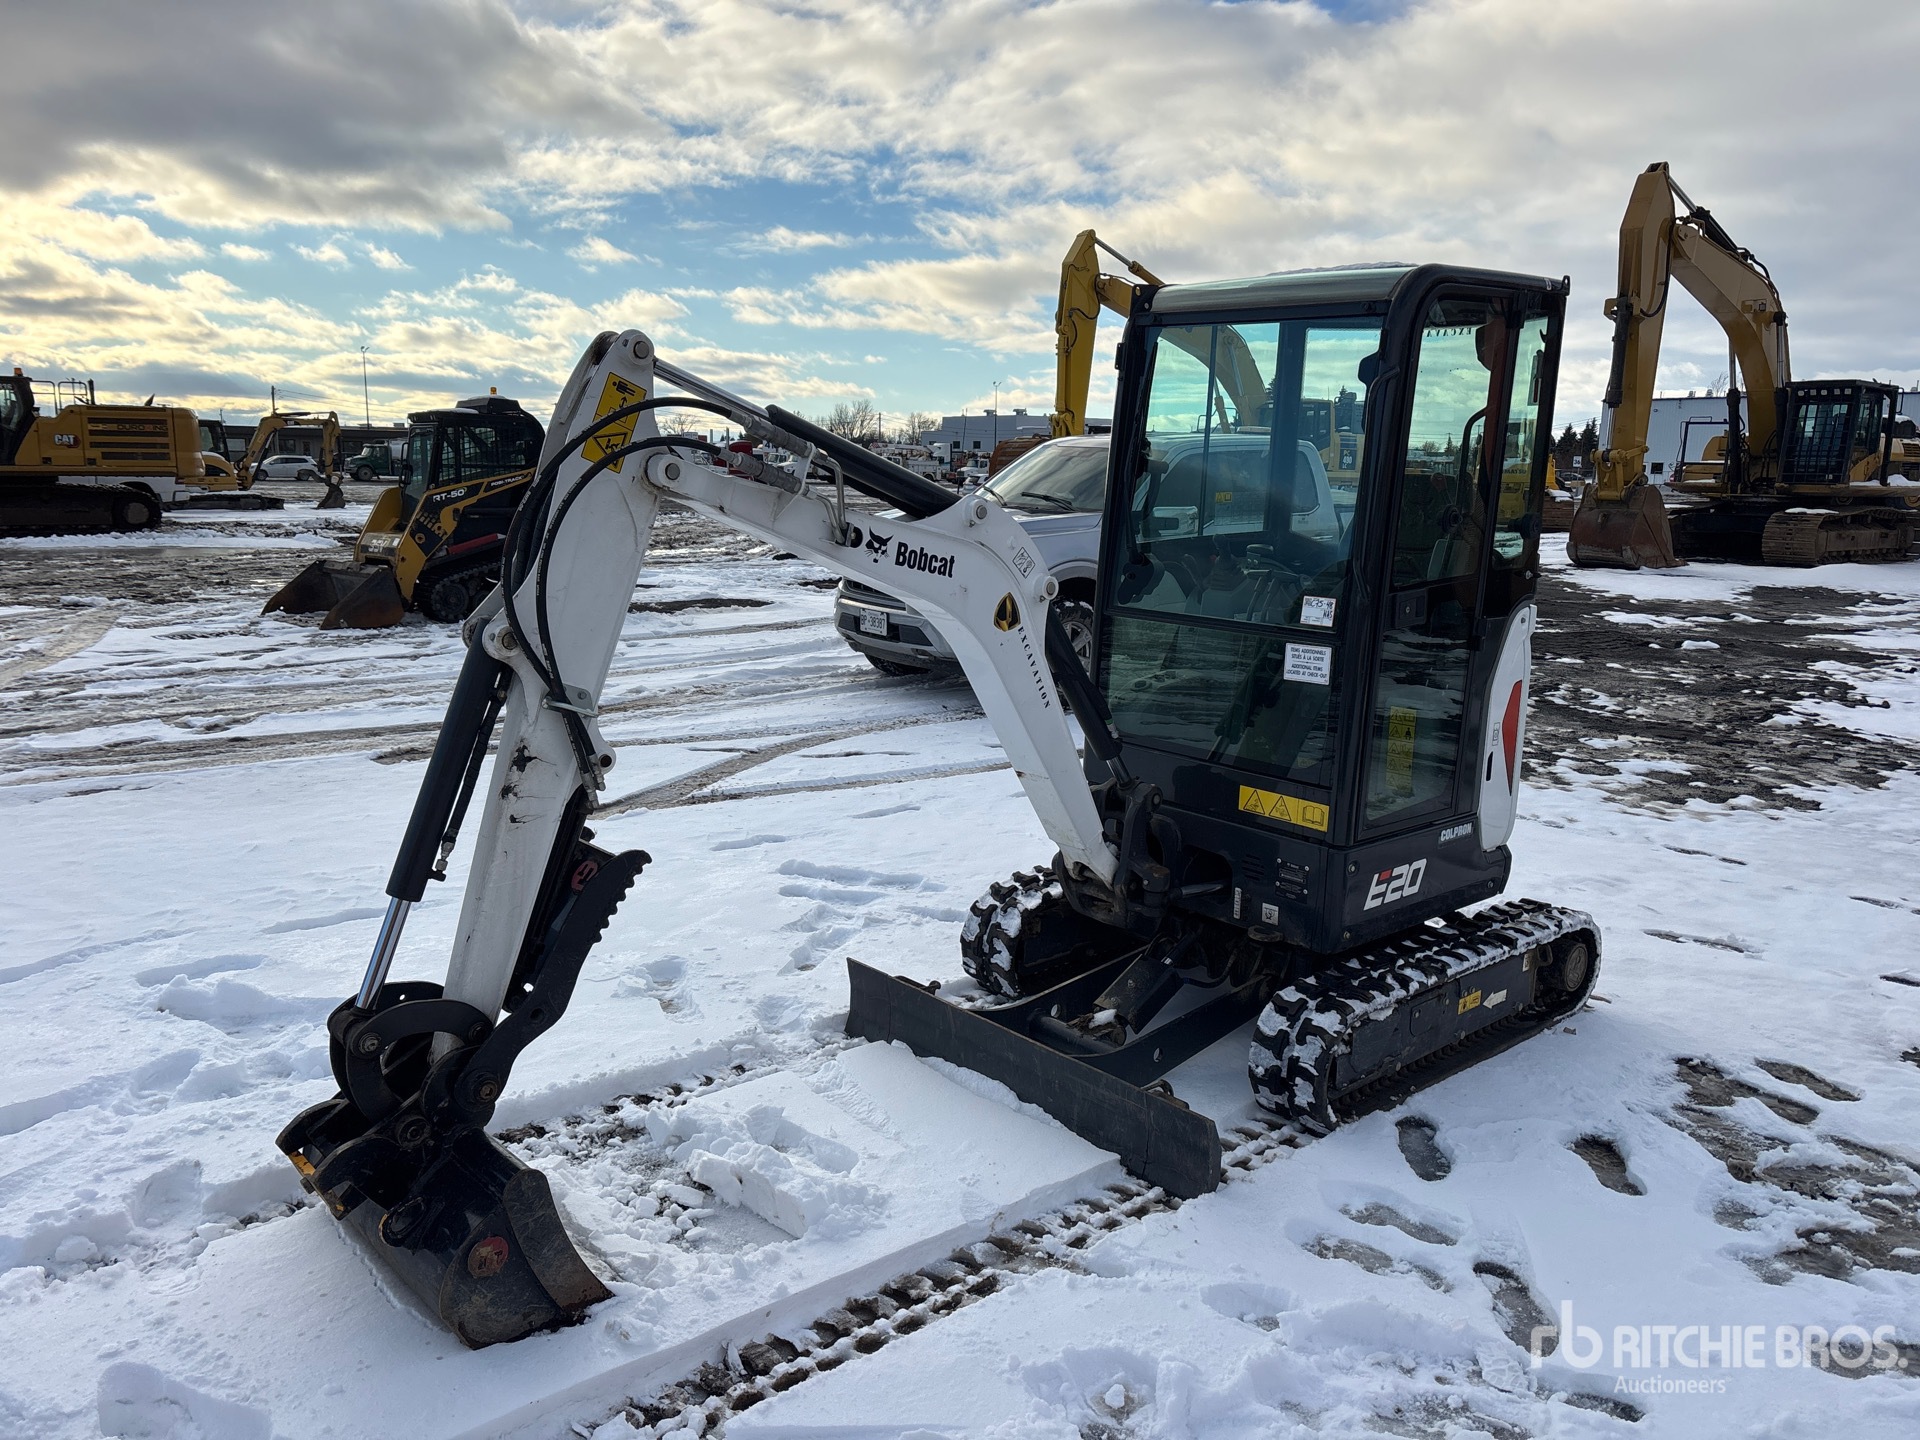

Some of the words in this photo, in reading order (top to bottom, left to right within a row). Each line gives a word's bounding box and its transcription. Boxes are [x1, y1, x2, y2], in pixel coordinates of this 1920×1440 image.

[54, 434, 75, 445] CAT
[432, 489, 465, 503] RT-50
[894, 541, 956, 579] Bobcat
[1017, 626, 1051, 709] EXCAVATION
[1440, 822, 1473, 842] COLPRON
[1363, 858, 1427, 911] E20
